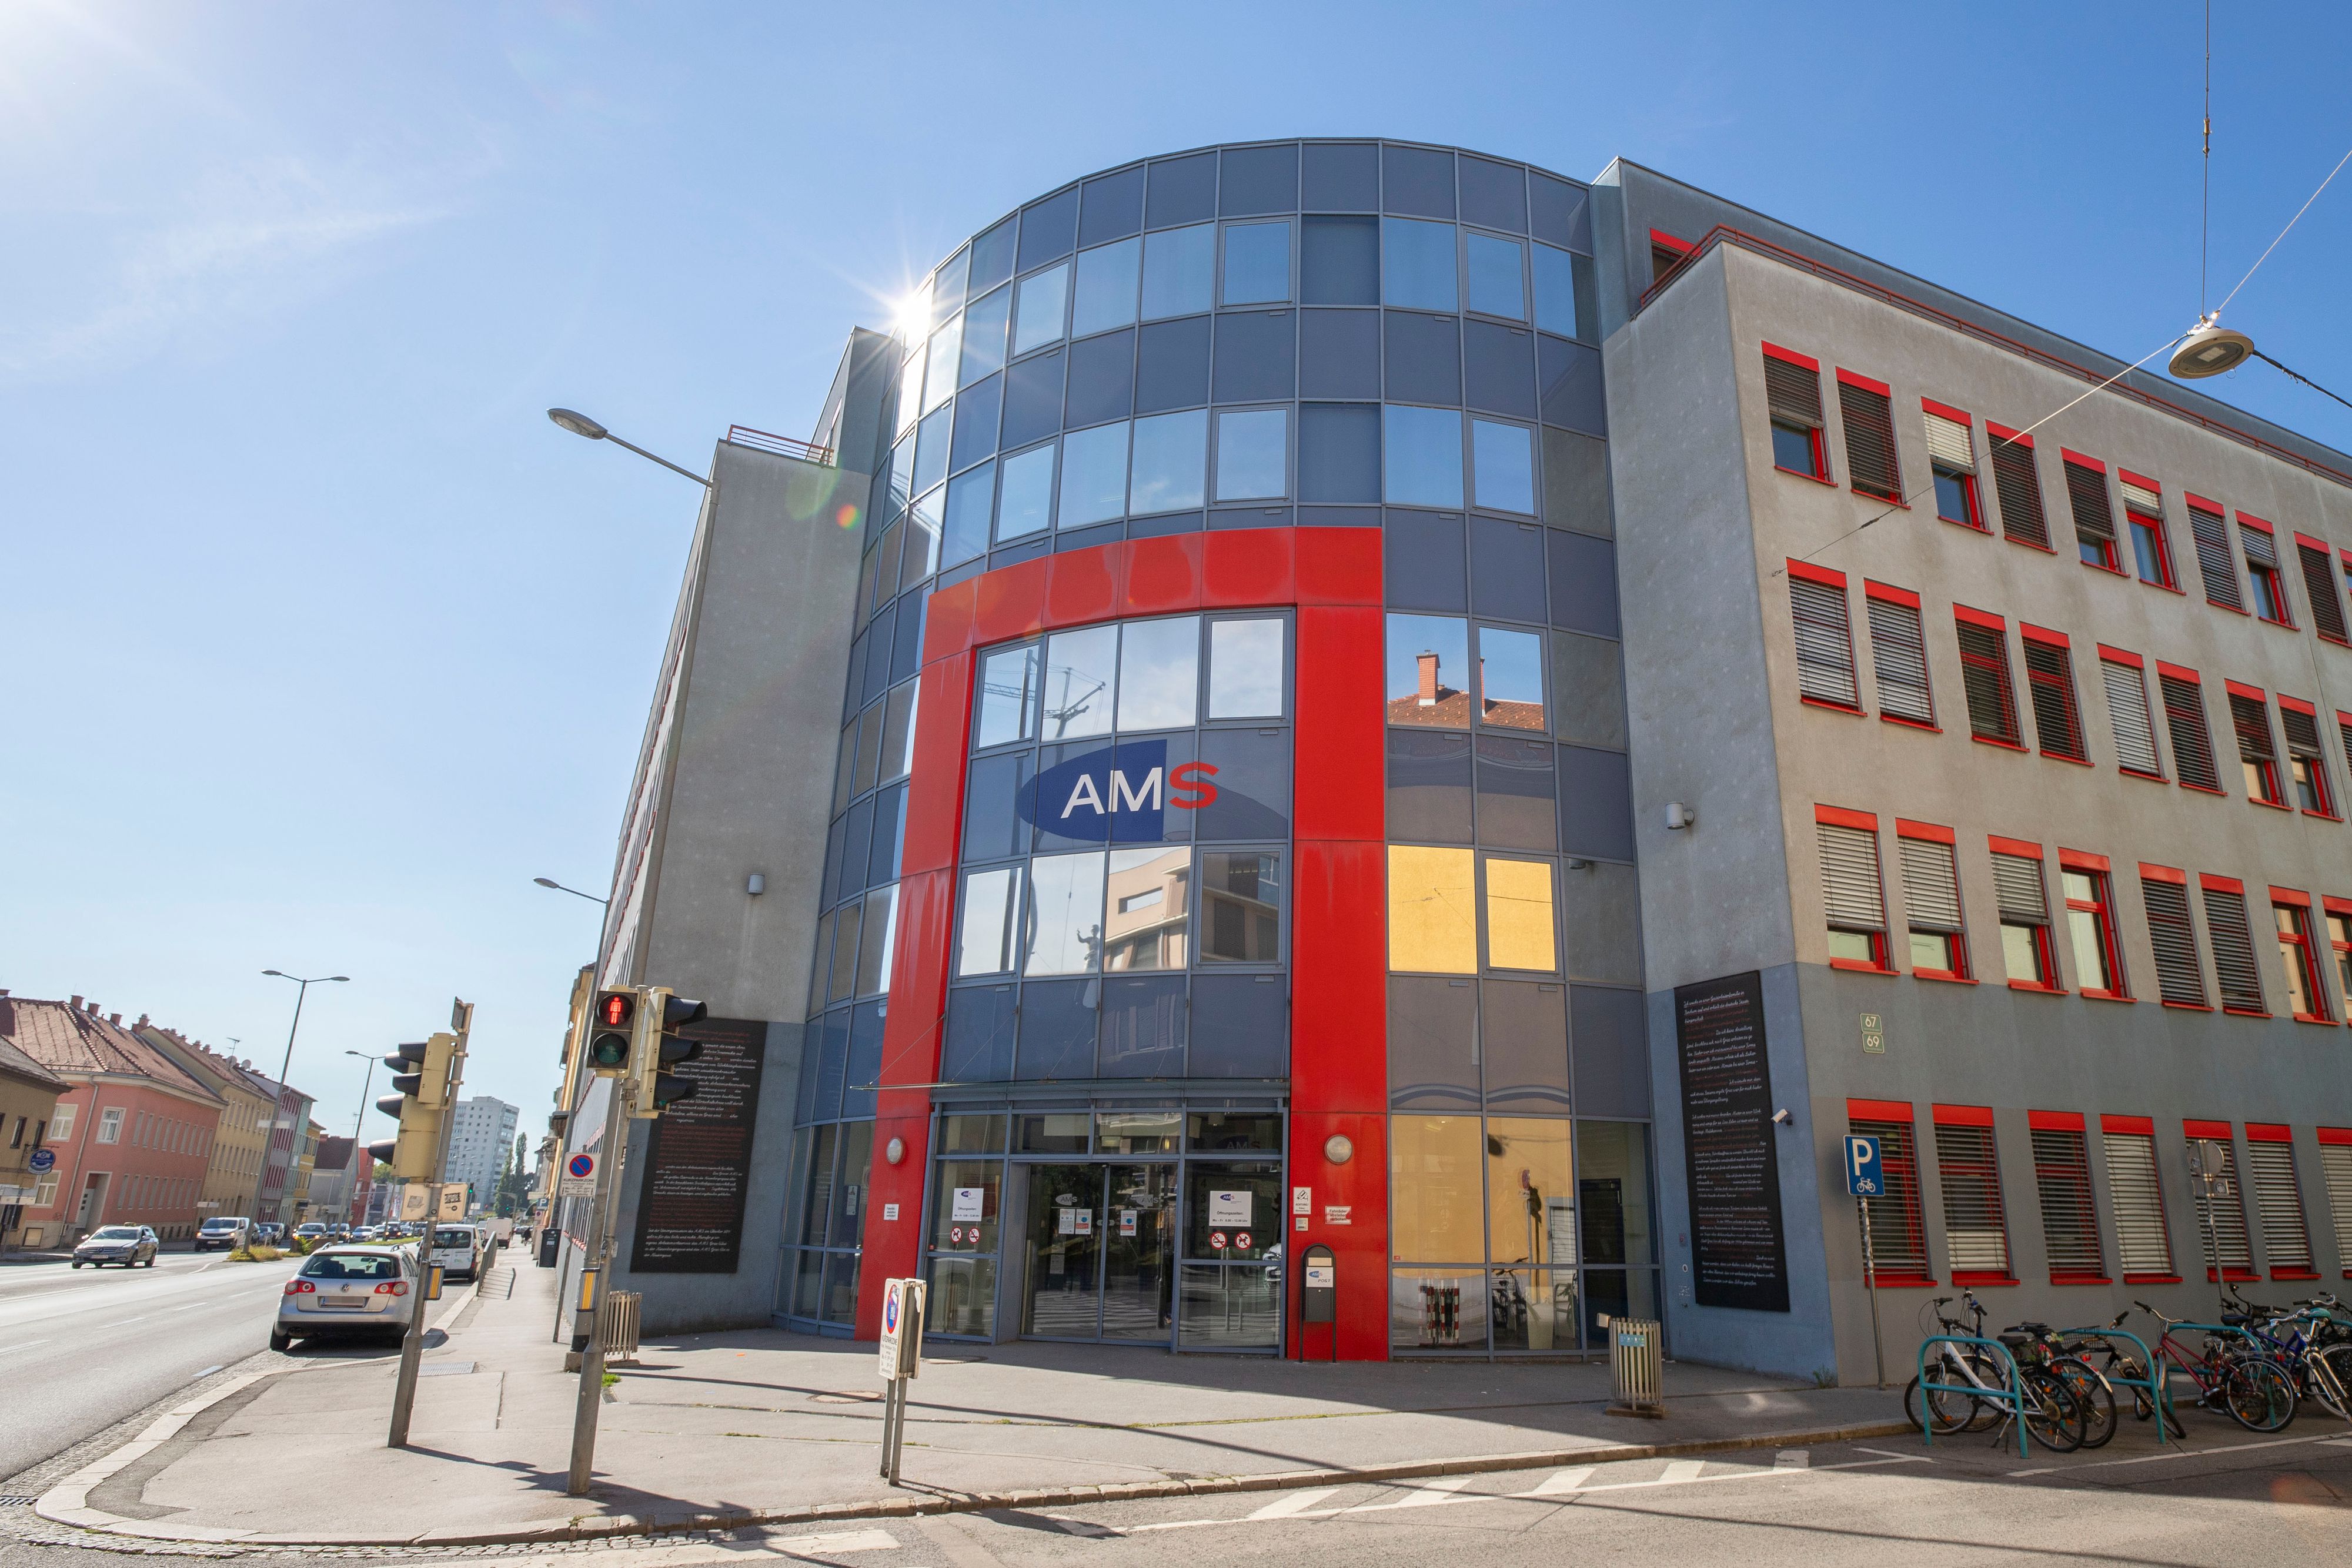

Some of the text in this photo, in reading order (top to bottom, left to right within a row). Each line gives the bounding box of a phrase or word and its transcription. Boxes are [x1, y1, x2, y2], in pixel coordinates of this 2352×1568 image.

[1060, 761, 1220, 819] AMS
[1865, 1016, 1876, 1027] 67
[1867, 1035, 1879, 1047] 69
[1852, 1138, 1872, 1176] P
